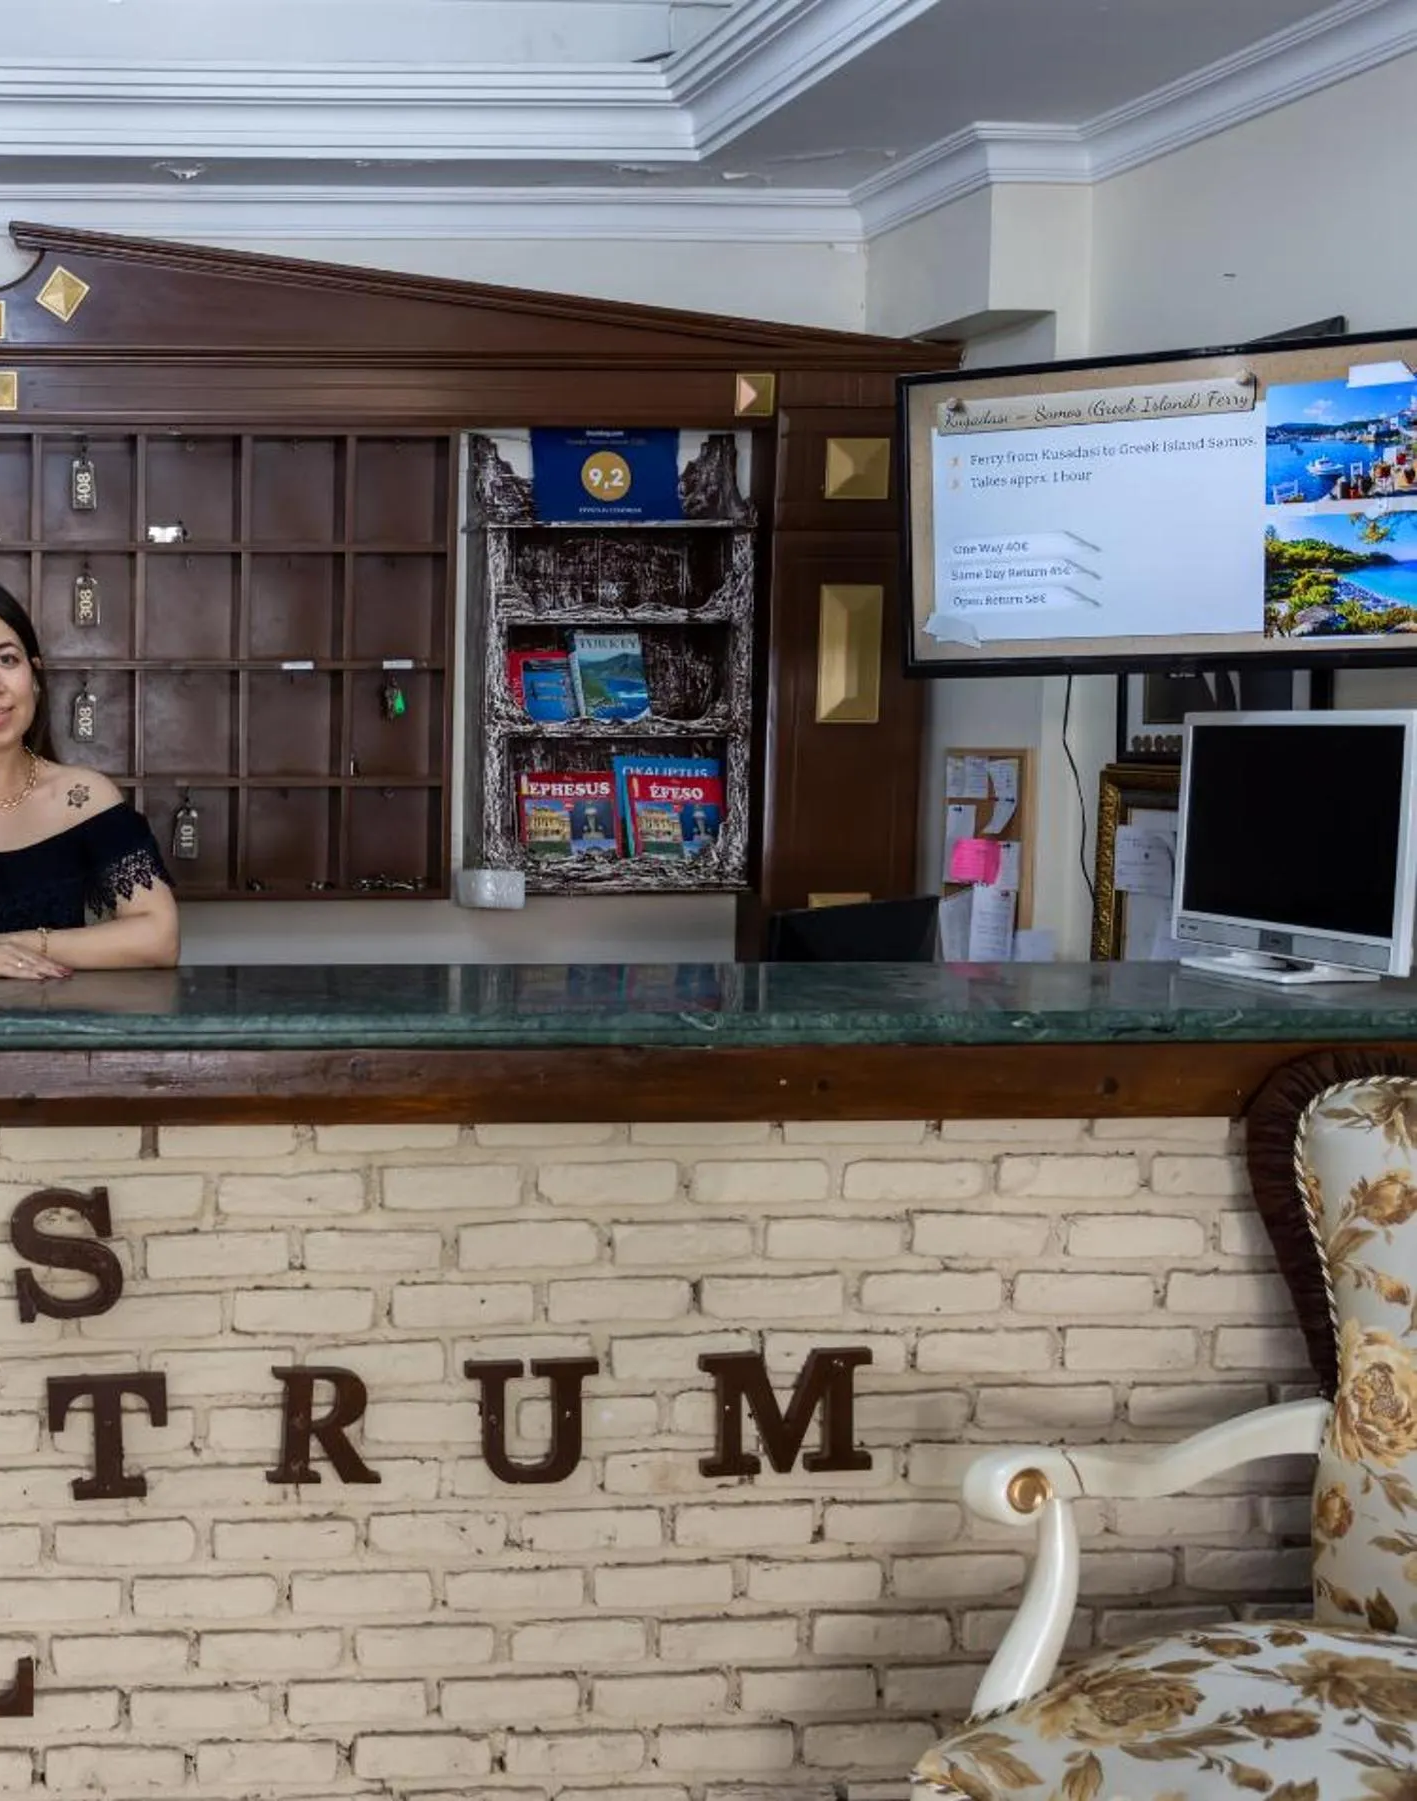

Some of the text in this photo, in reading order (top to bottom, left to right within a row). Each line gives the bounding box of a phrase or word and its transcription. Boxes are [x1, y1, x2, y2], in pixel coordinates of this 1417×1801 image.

[1034, 404, 1082, 422] Samos
[1140, 393, 1200, 413] Island)
[1207, 391, 1248, 409] Ferry
[970, 454, 1005, 467] Ferry
[1007, 450, 1038, 463] from
[1103, 445, 1115, 457] to
[1119, 440, 1160, 455] Greek
[1162, 437, 1205, 453] Island
[76, 472, 91, 503] 408
[589, 468, 624, 490] 9,2
[970, 475, 1007, 489] Takes
[1060, 470, 1093, 483] hour
[953, 545, 978, 555] One
[979, 543, 1004, 555] Way
[951, 569, 981, 581] Same
[985, 568, 1006, 580] Day
[1008, 566, 1047, 578] Return
[79, 589, 93, 619] 308
[953, 596, 983, 608] Open
[985, 594, 1023, 606] Return
[78, 706, 93, 736] 208
[530, 781, 611, 797] EPHESUS
[180, 825, 194, 848] 110
